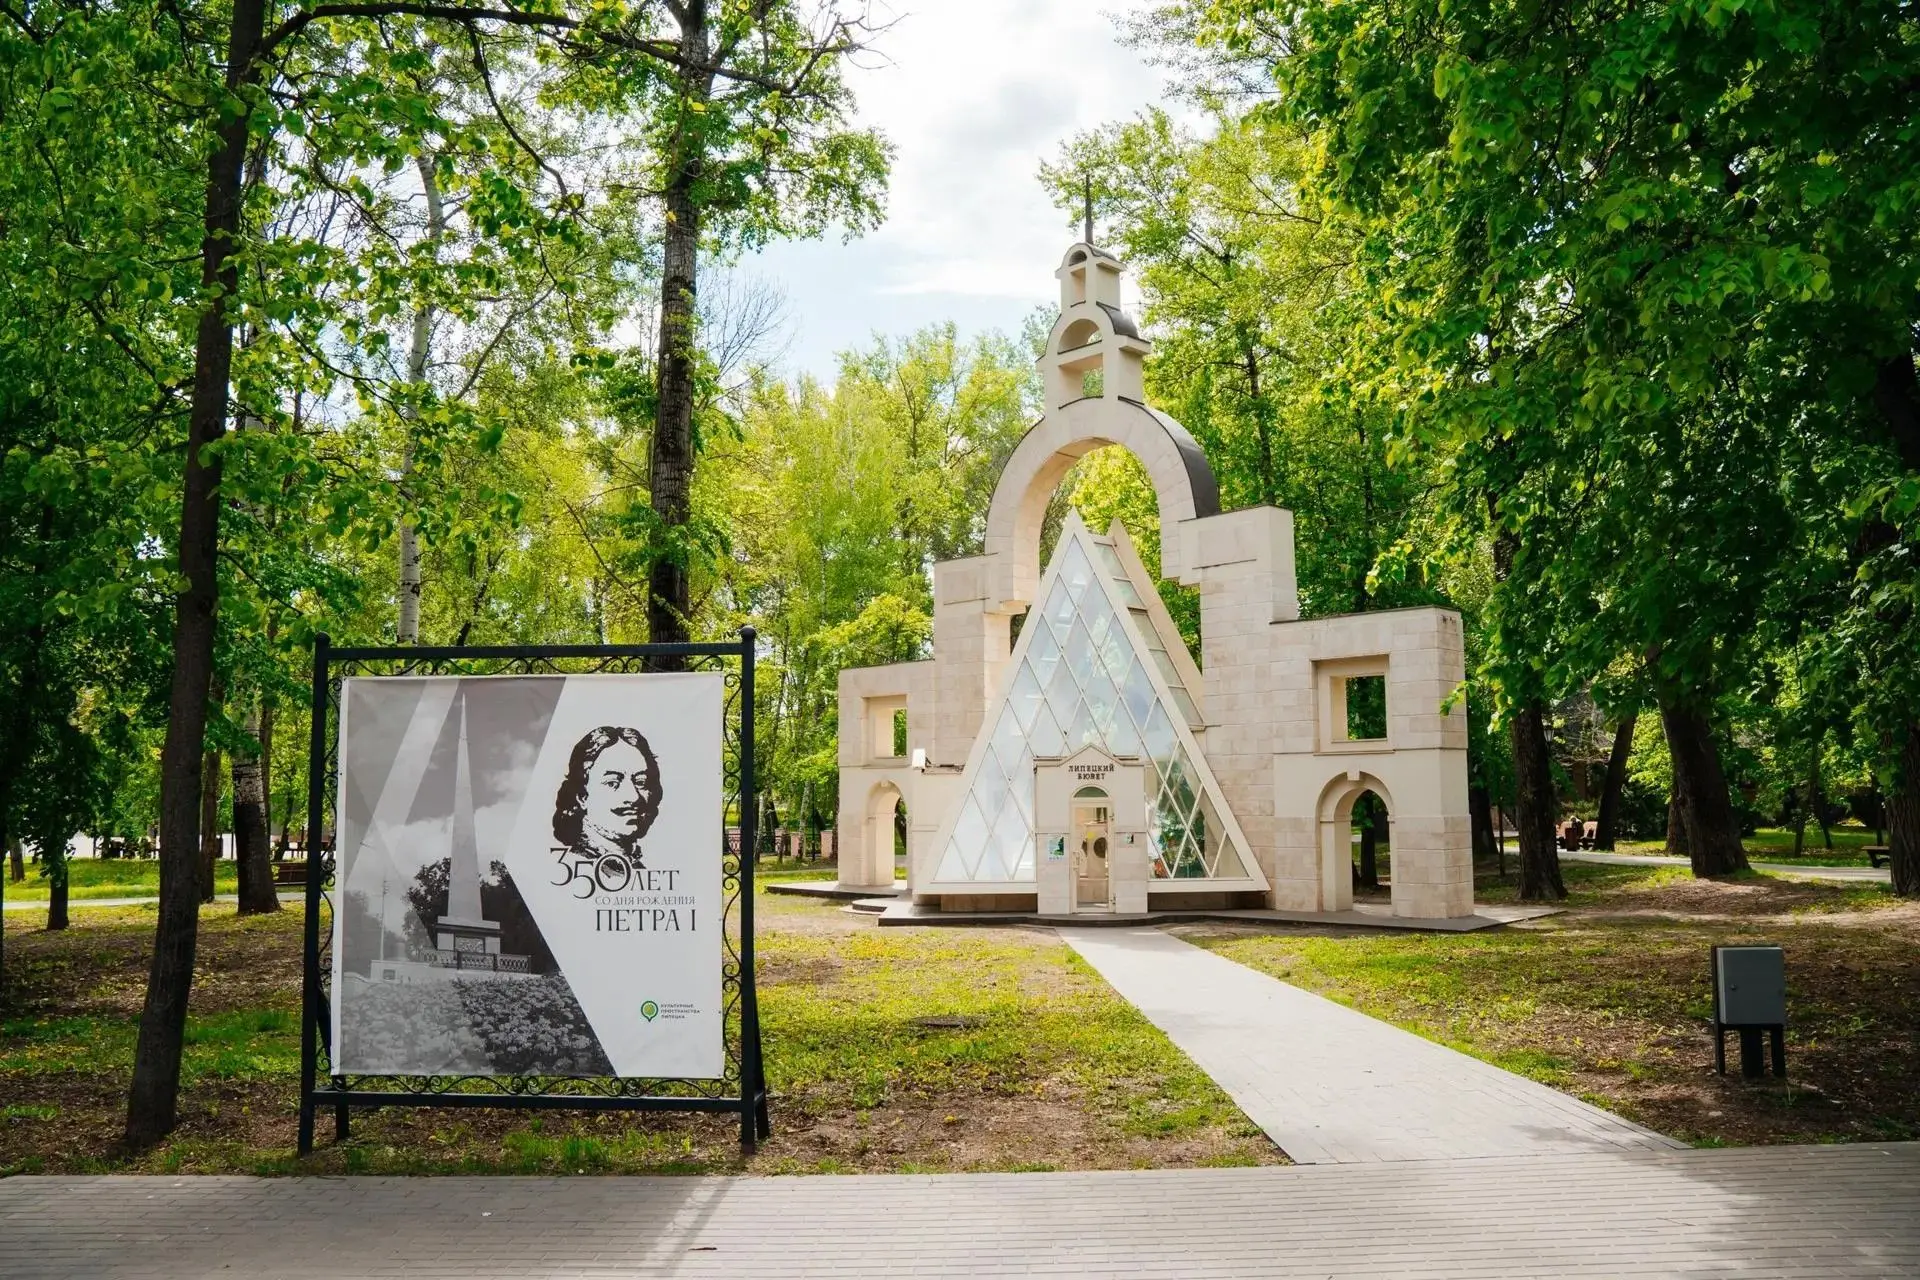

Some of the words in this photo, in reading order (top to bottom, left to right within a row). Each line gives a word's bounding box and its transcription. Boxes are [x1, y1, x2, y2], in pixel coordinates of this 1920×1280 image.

[1068, 763, 1114, 772] ЛИПЕЦКИЙ
[1077, 772, 1105, 780] БЮВЕТ
[550, 846, 632, 899] 350
[630, 870, 680, 891] ЛЕТ
[595, 896, 611, 906] СО
[613, 896, 634, 906] ДНЯ
[636, 895, 696, 906] РОЖДЕНИЯ
[596, 909, 680, 932] ПЕТРА
[690, 909, 697, 932] I
